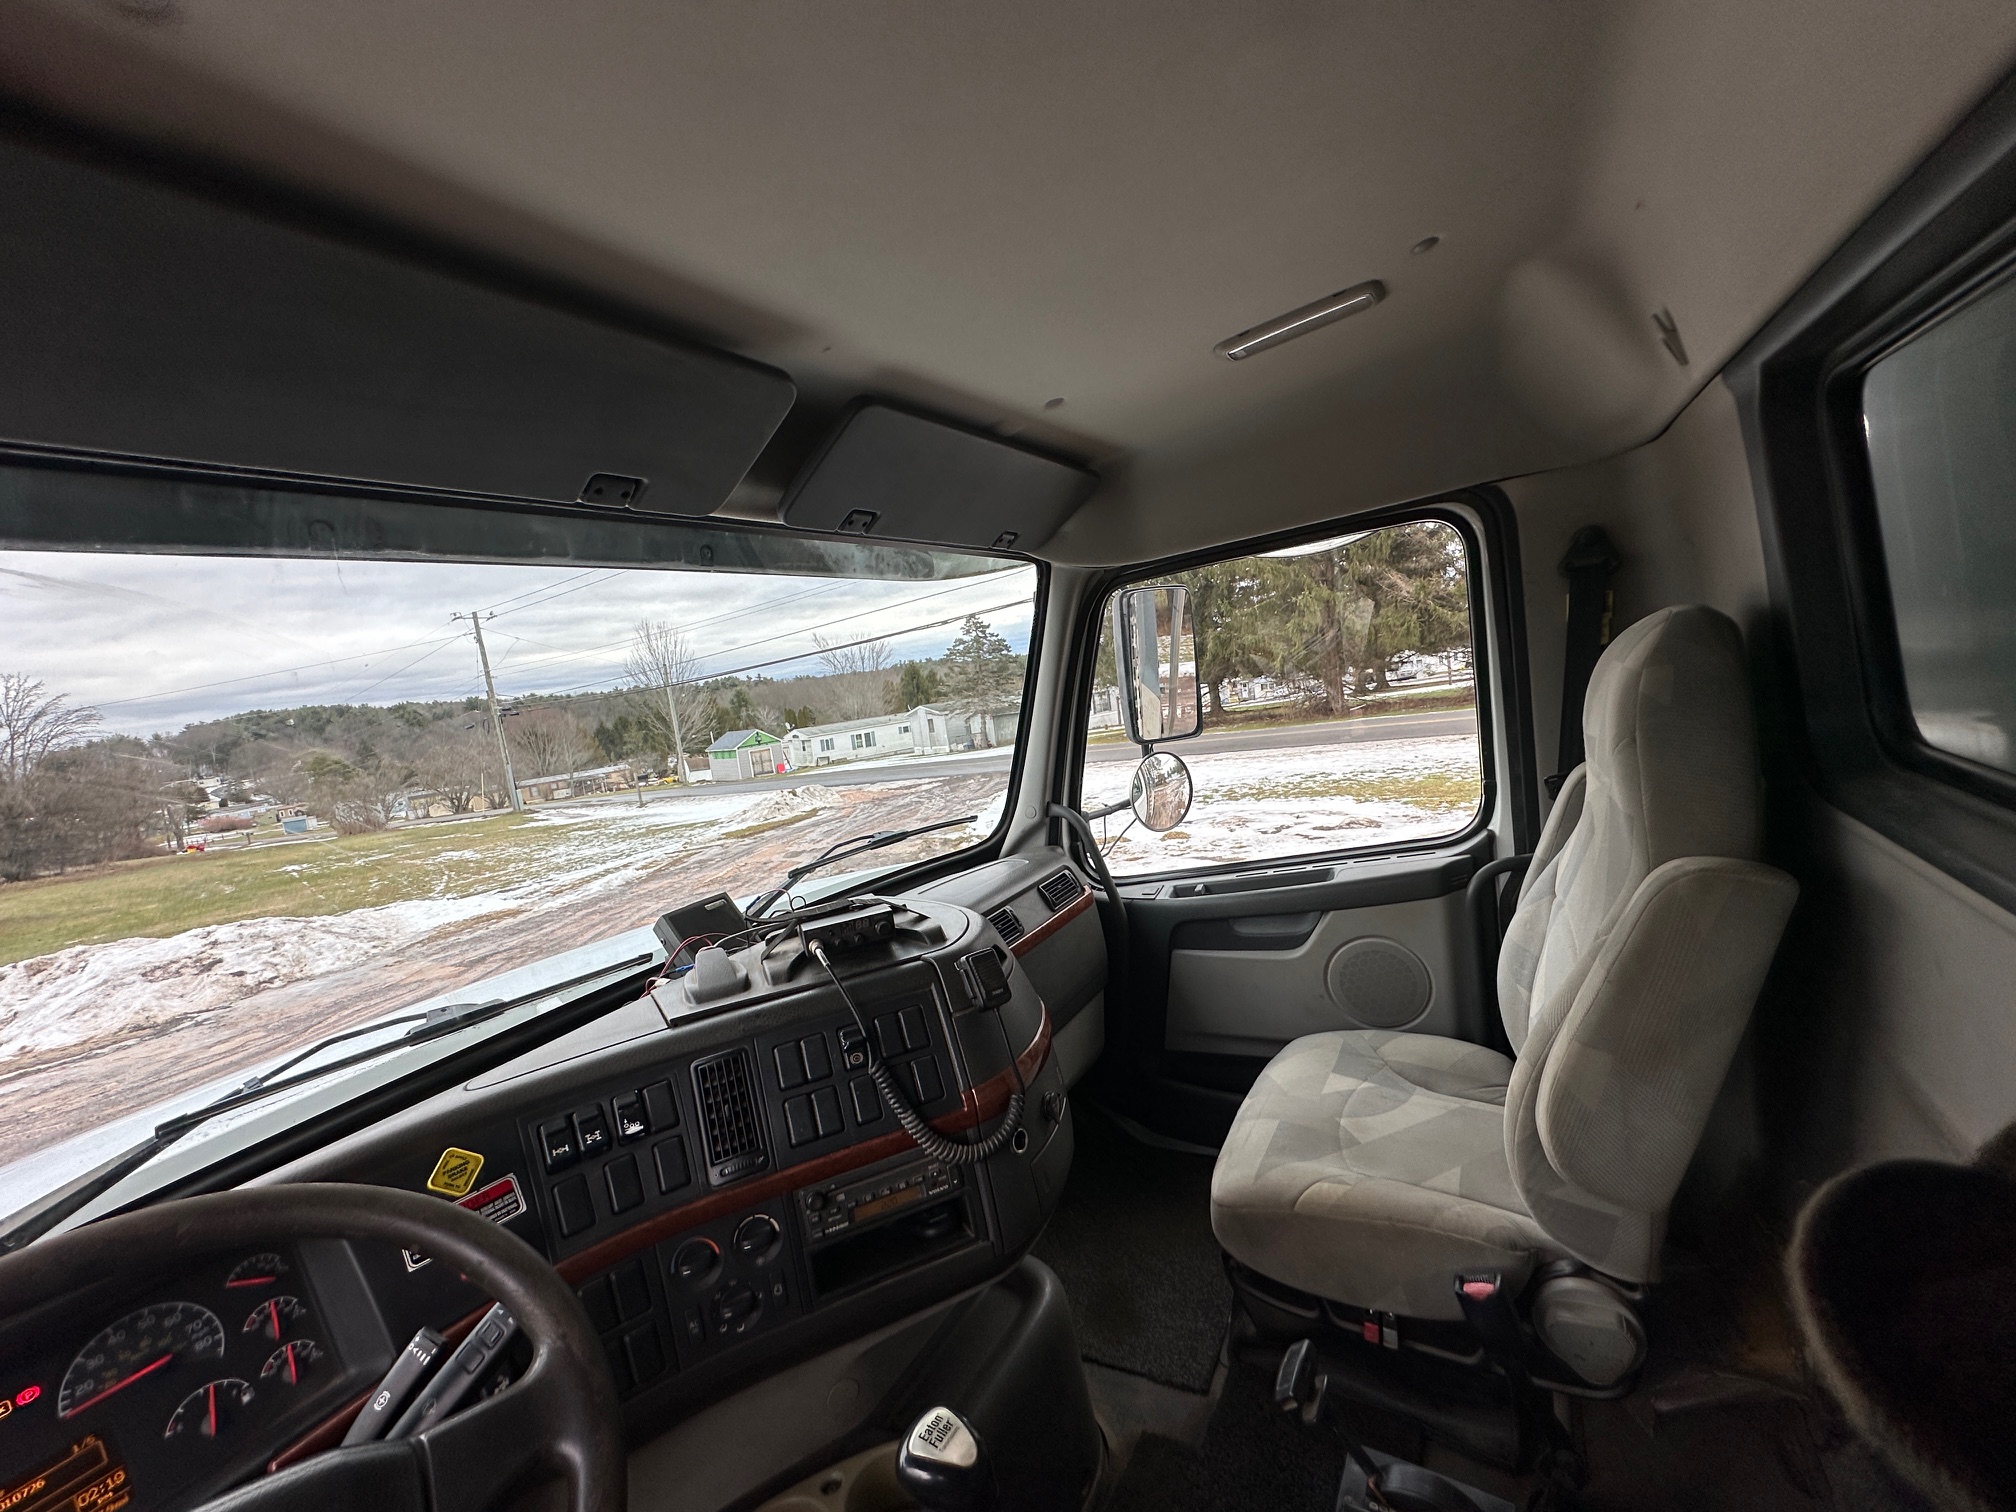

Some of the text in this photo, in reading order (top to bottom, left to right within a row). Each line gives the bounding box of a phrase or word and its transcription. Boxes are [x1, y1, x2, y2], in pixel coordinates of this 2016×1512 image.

[185, 1318, 202, 1334] 70
[75, 1379, 95, 1397] 20
[918, 1414, 944, 1442] Eaton
[928, 1418, 954, 1449] Fuller
